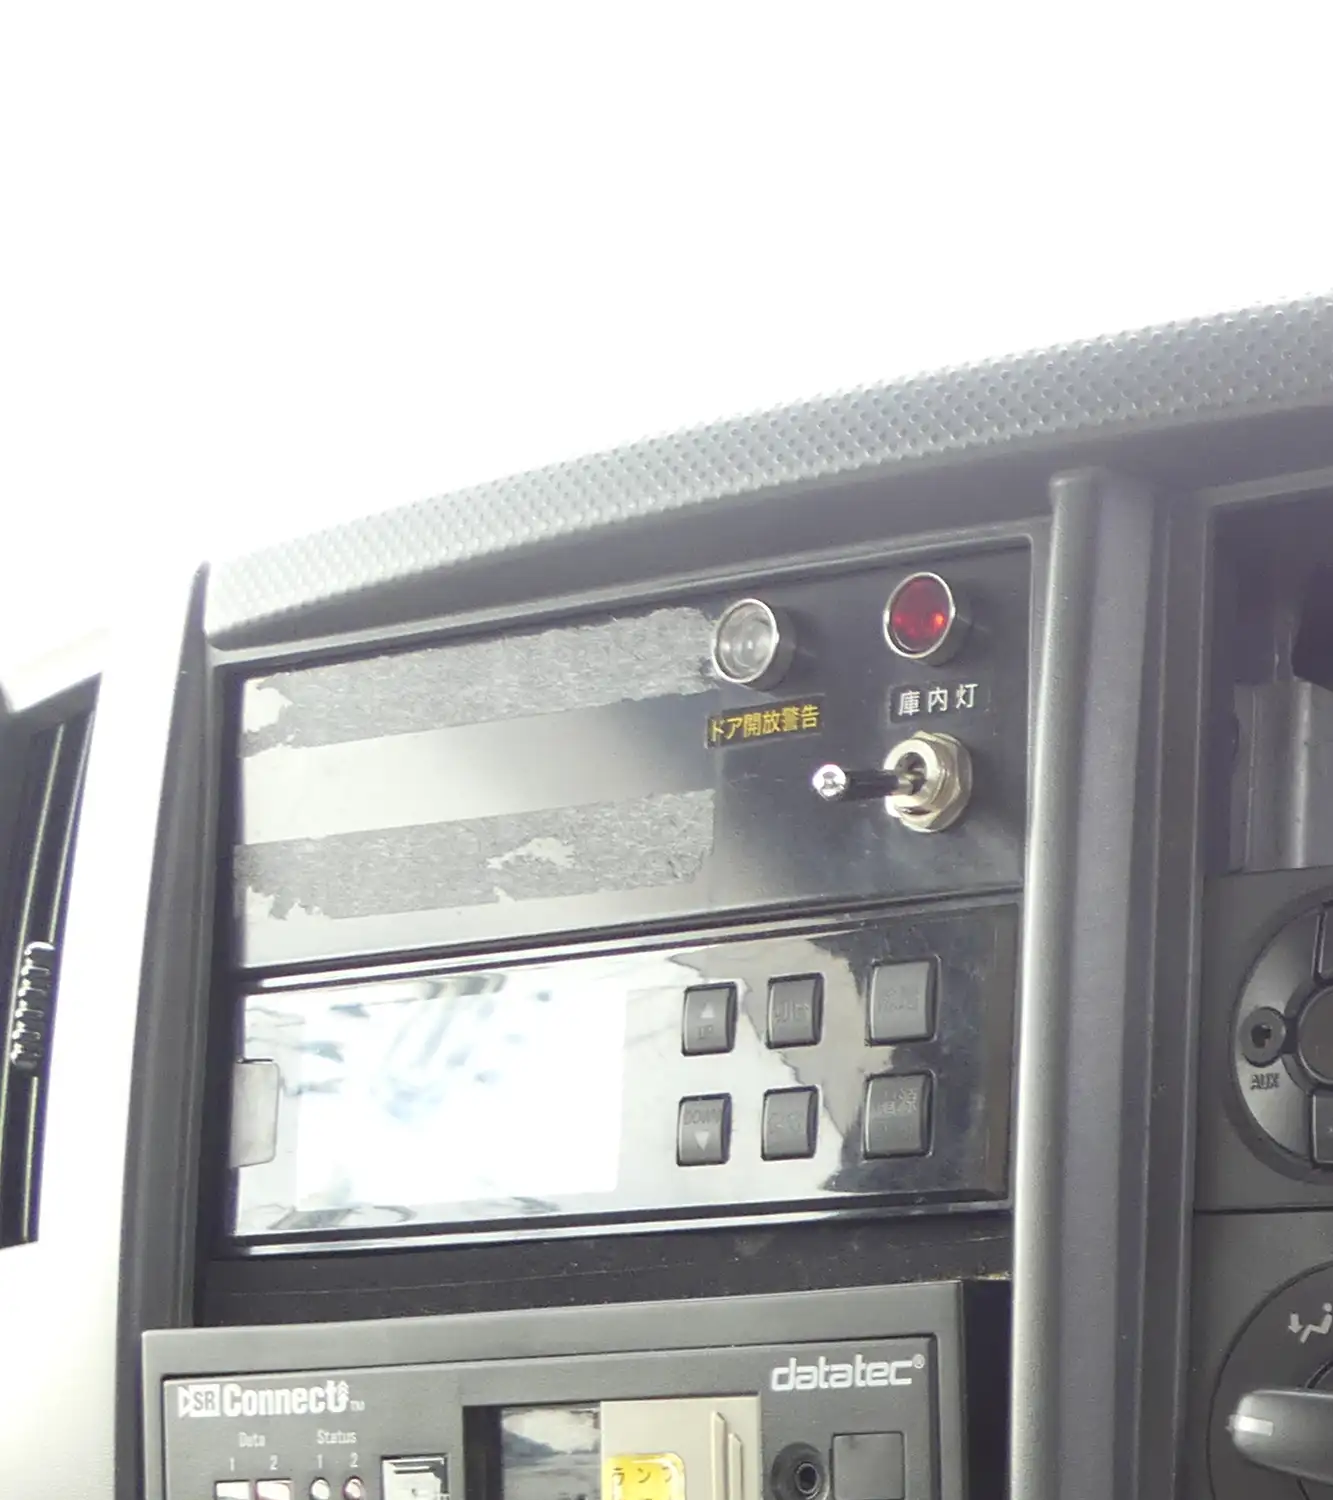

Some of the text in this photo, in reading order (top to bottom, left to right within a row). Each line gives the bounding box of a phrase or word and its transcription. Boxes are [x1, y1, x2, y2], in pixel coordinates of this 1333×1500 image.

[898, 682, 979, 717] 庫内灯
[708, 703, 820, 743] ドア開放警告
[1250, 1072, 1281, 1091] AUX
[770, 1354, 913, 1393] datatec
[316, 1429, 357, 1445] Status
